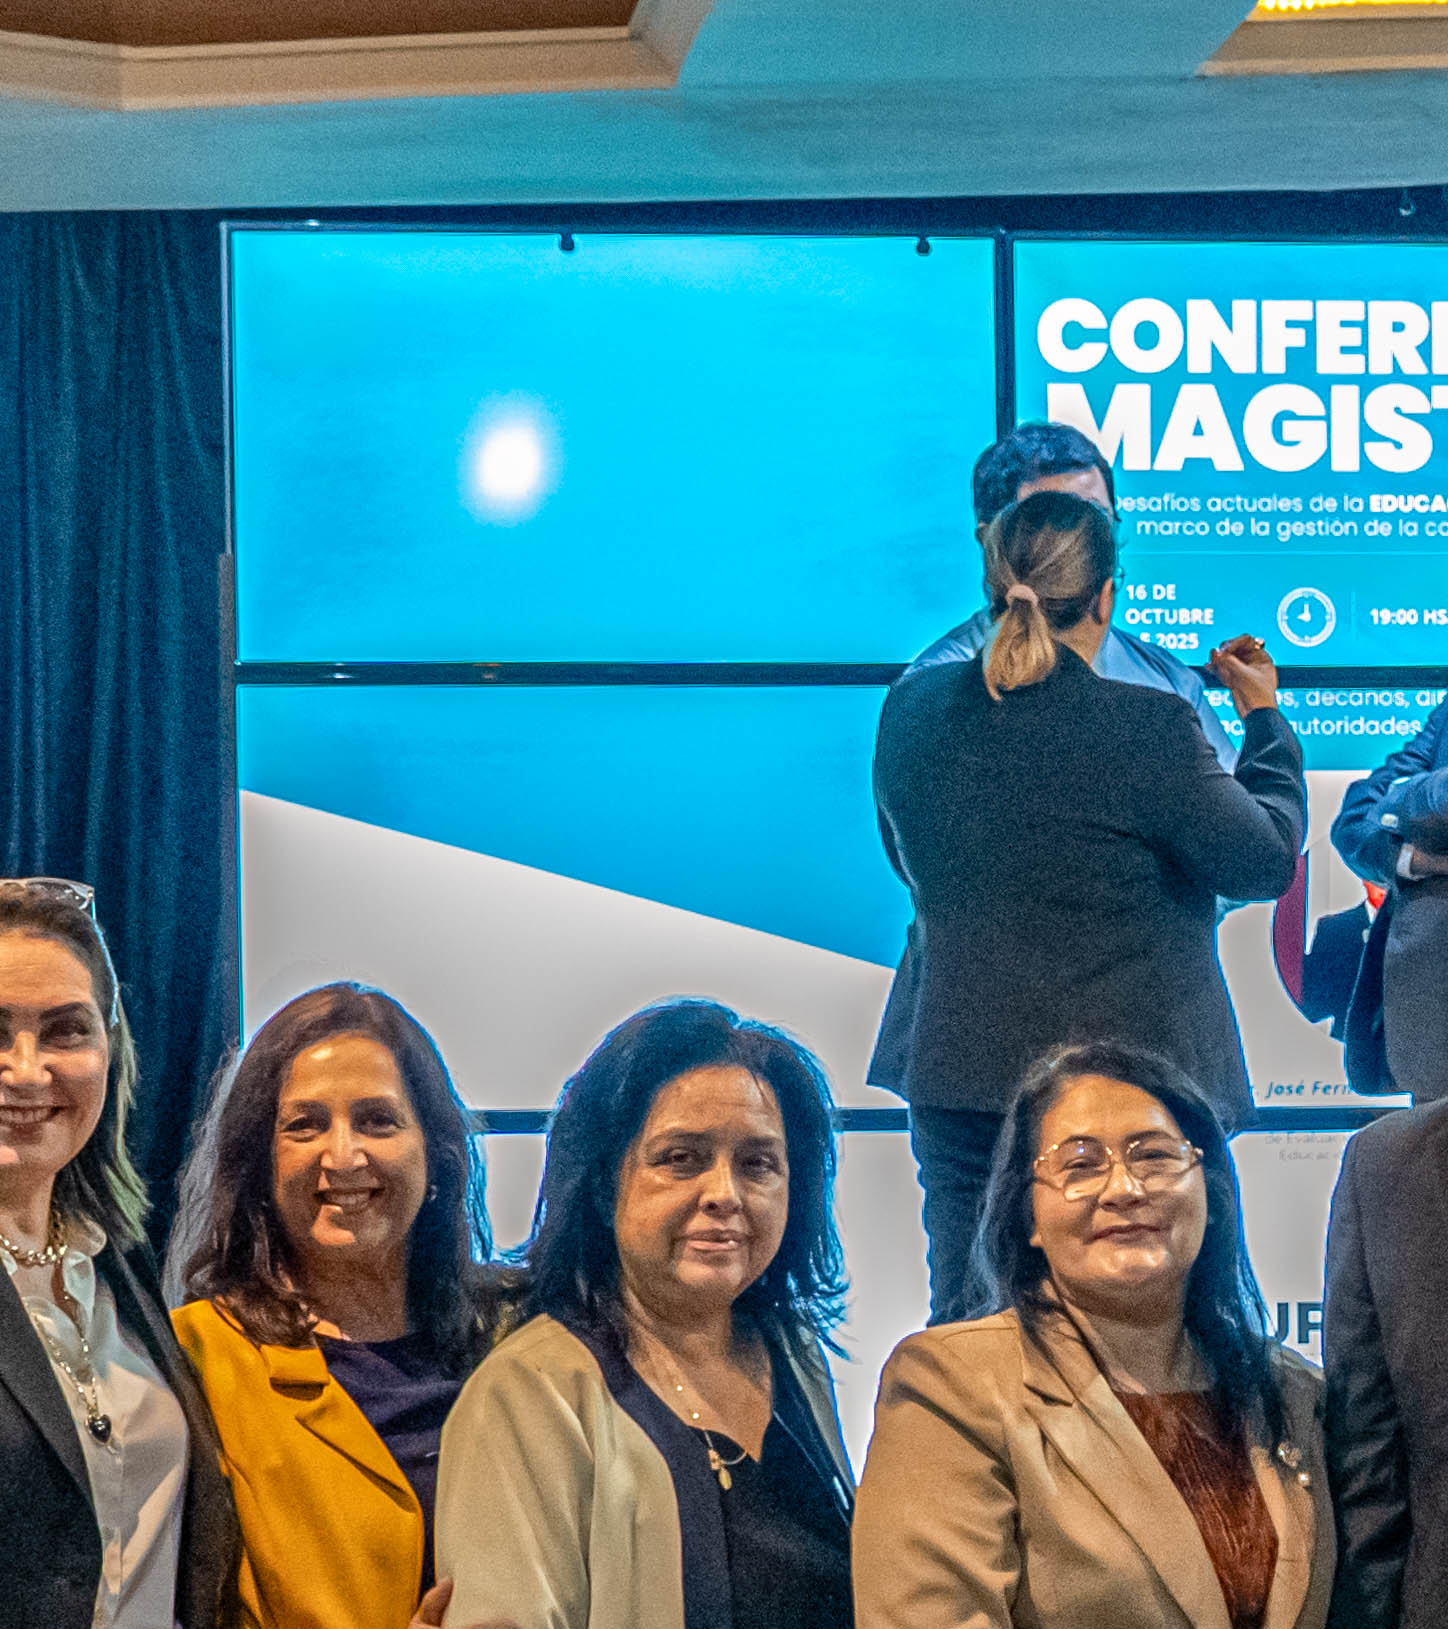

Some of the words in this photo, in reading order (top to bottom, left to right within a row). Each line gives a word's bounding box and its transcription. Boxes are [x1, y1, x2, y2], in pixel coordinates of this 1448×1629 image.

[1207, 493, 1302, 512] actuales
[1309, 493, 1337, 512] de
[1343, 494, 1364, 512] la
[1136, 520, 1210, 535] marco
[1215, 518, 1244, 536] de
[1250, 517, 1270, 536] la
[1276, 517, 1358, 542] gestión
[1364, 518, 1392, 536] de
[1398, 518, 1419, 536] la
[1126, 584, 1147, 600] 16
[1152, 584, 1176, 600] DE
[1125, 608, 1214, 625] OCTUBRE
[1370, 608, 1418, 625] 19:00
[1155, 633, 1199, 649] 2025
[1306, 689, 1410, 709] decanos,
[1264, 1080, 1305, 1100] José
